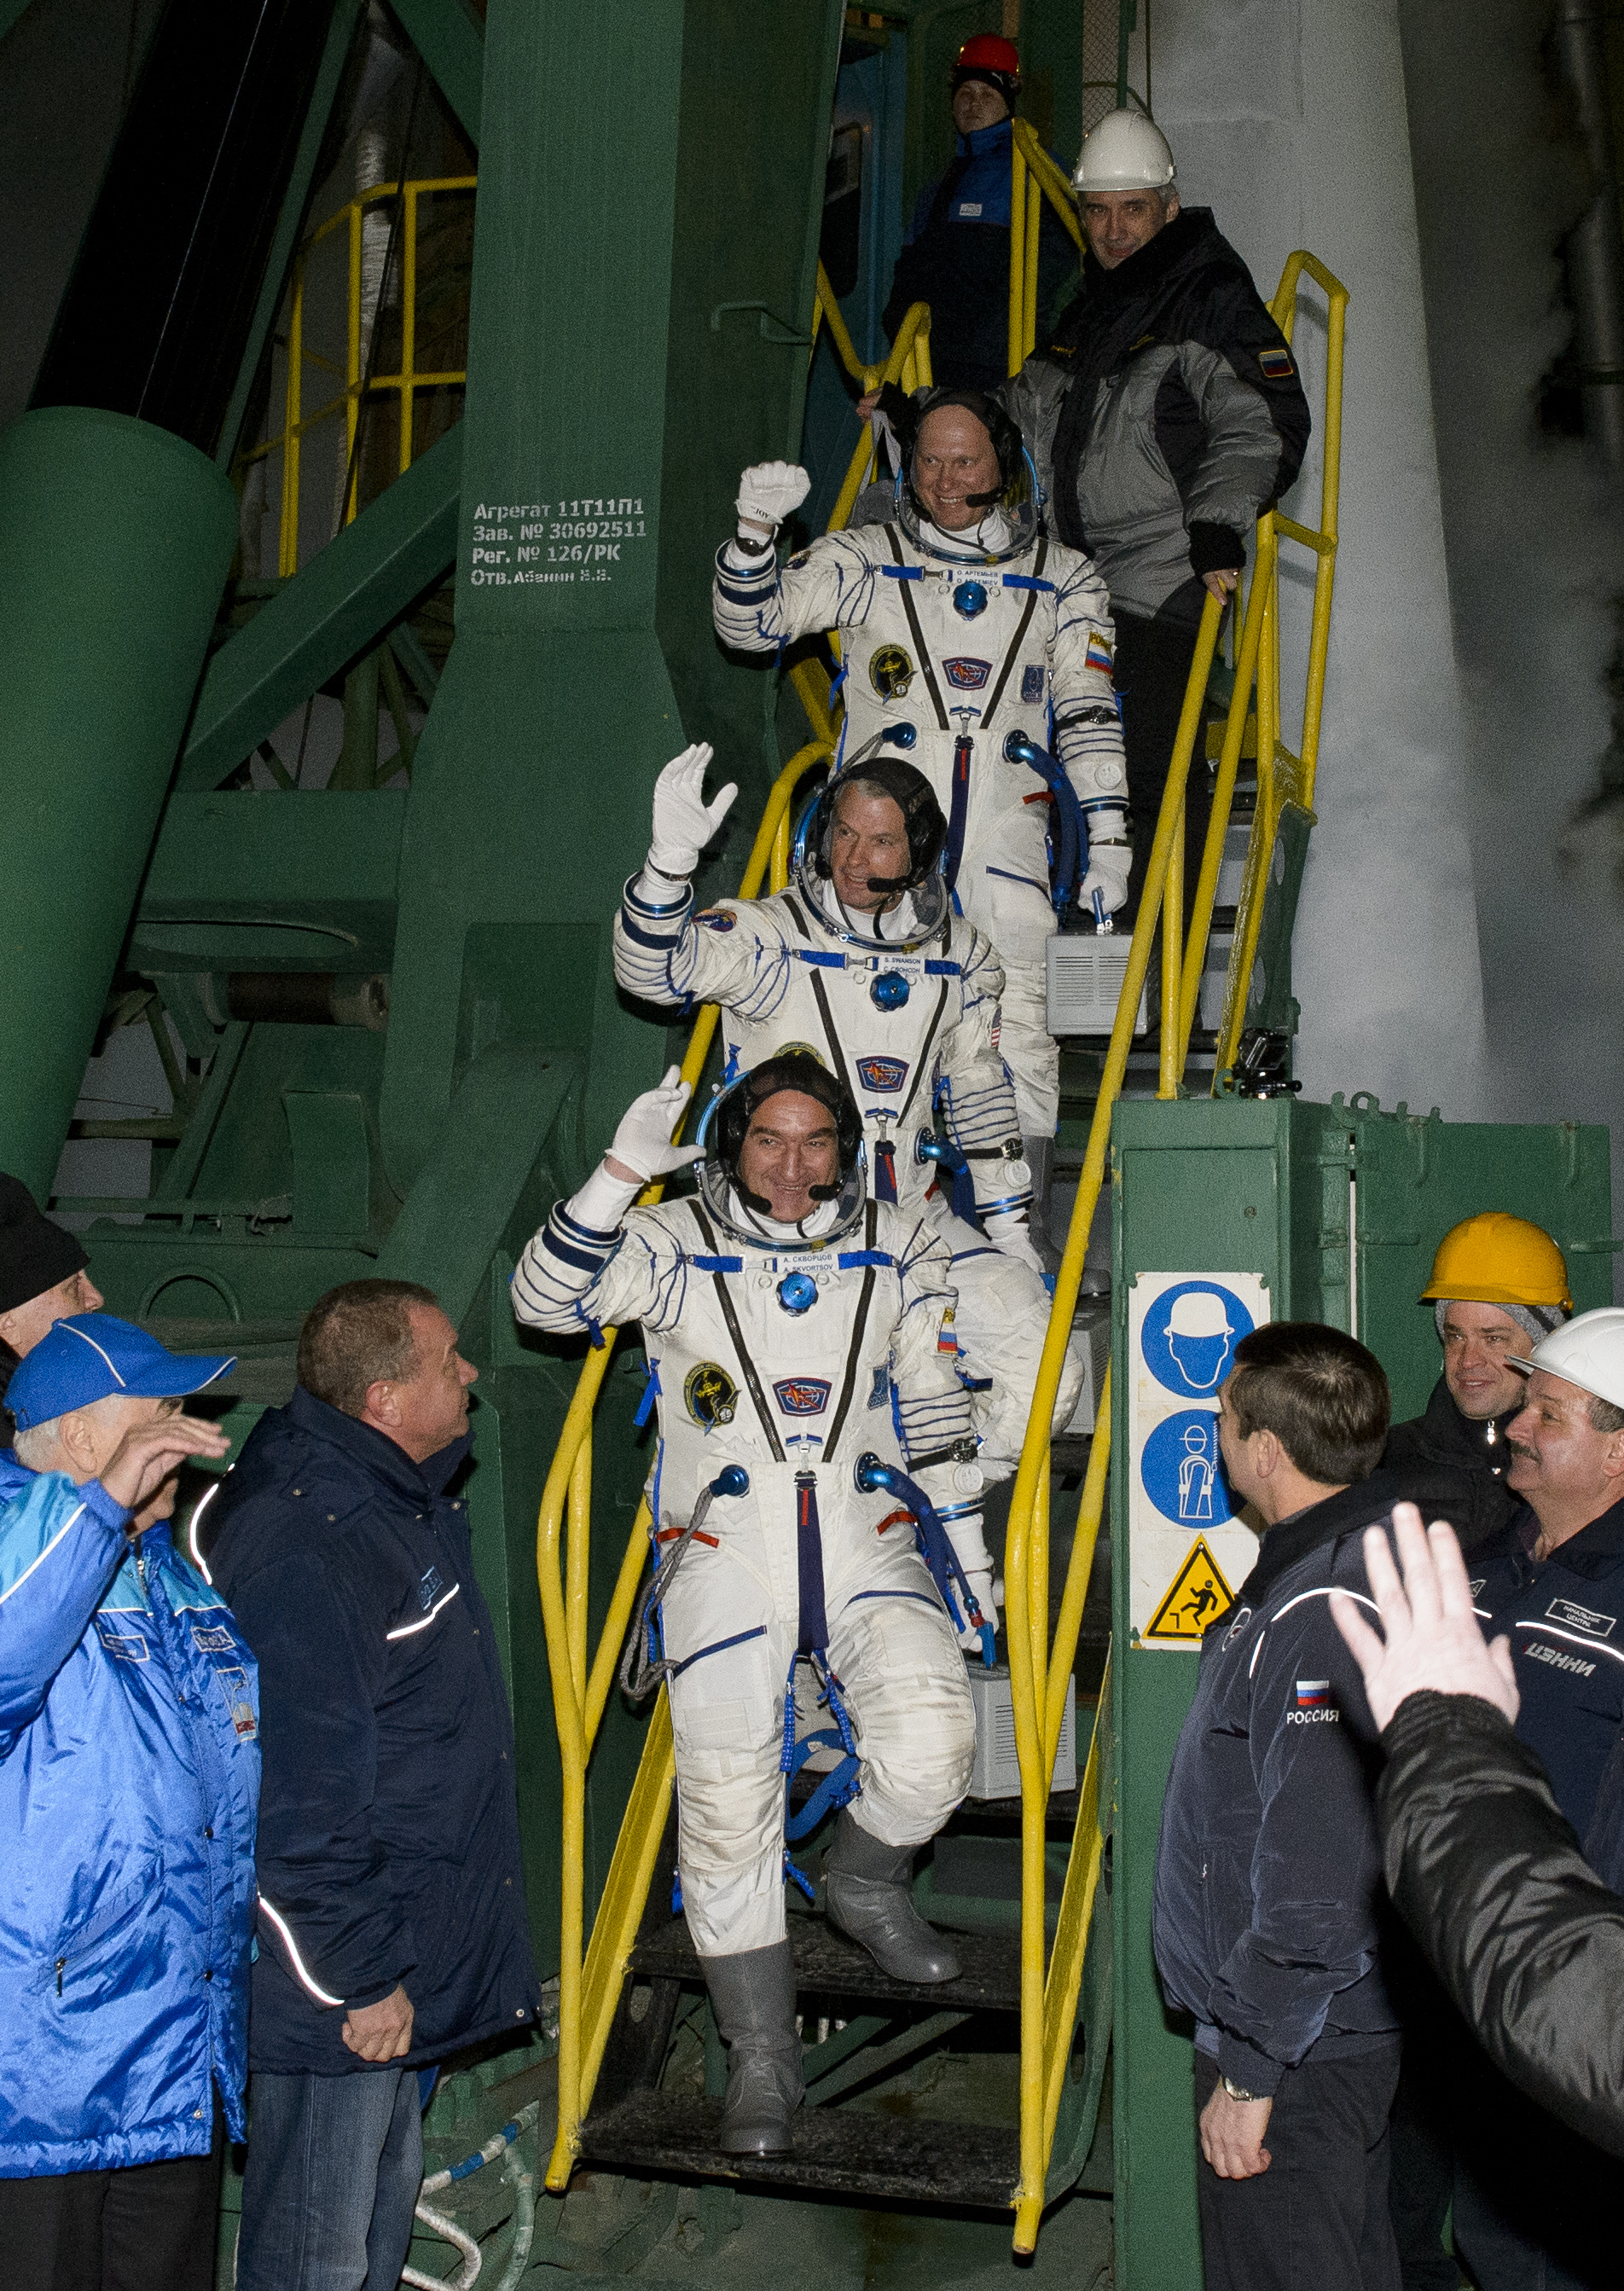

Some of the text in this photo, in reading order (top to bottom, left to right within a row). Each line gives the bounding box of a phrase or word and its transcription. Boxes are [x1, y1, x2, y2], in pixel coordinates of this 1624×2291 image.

[474, 503, 552, 523] Агрегат
[473, 521, 647, 542] Зав. № 30692511
[473, 544, 621, 564] Рег. № 126/РК
[471, 569, 512, 585] Отв.
[792, 1254, 832, 1262] СКВОРЦОВ
[792, 1263, 833, 1272] SKVORTSOV
[1286, 1708, 1340, 1725] РОССИЯ
